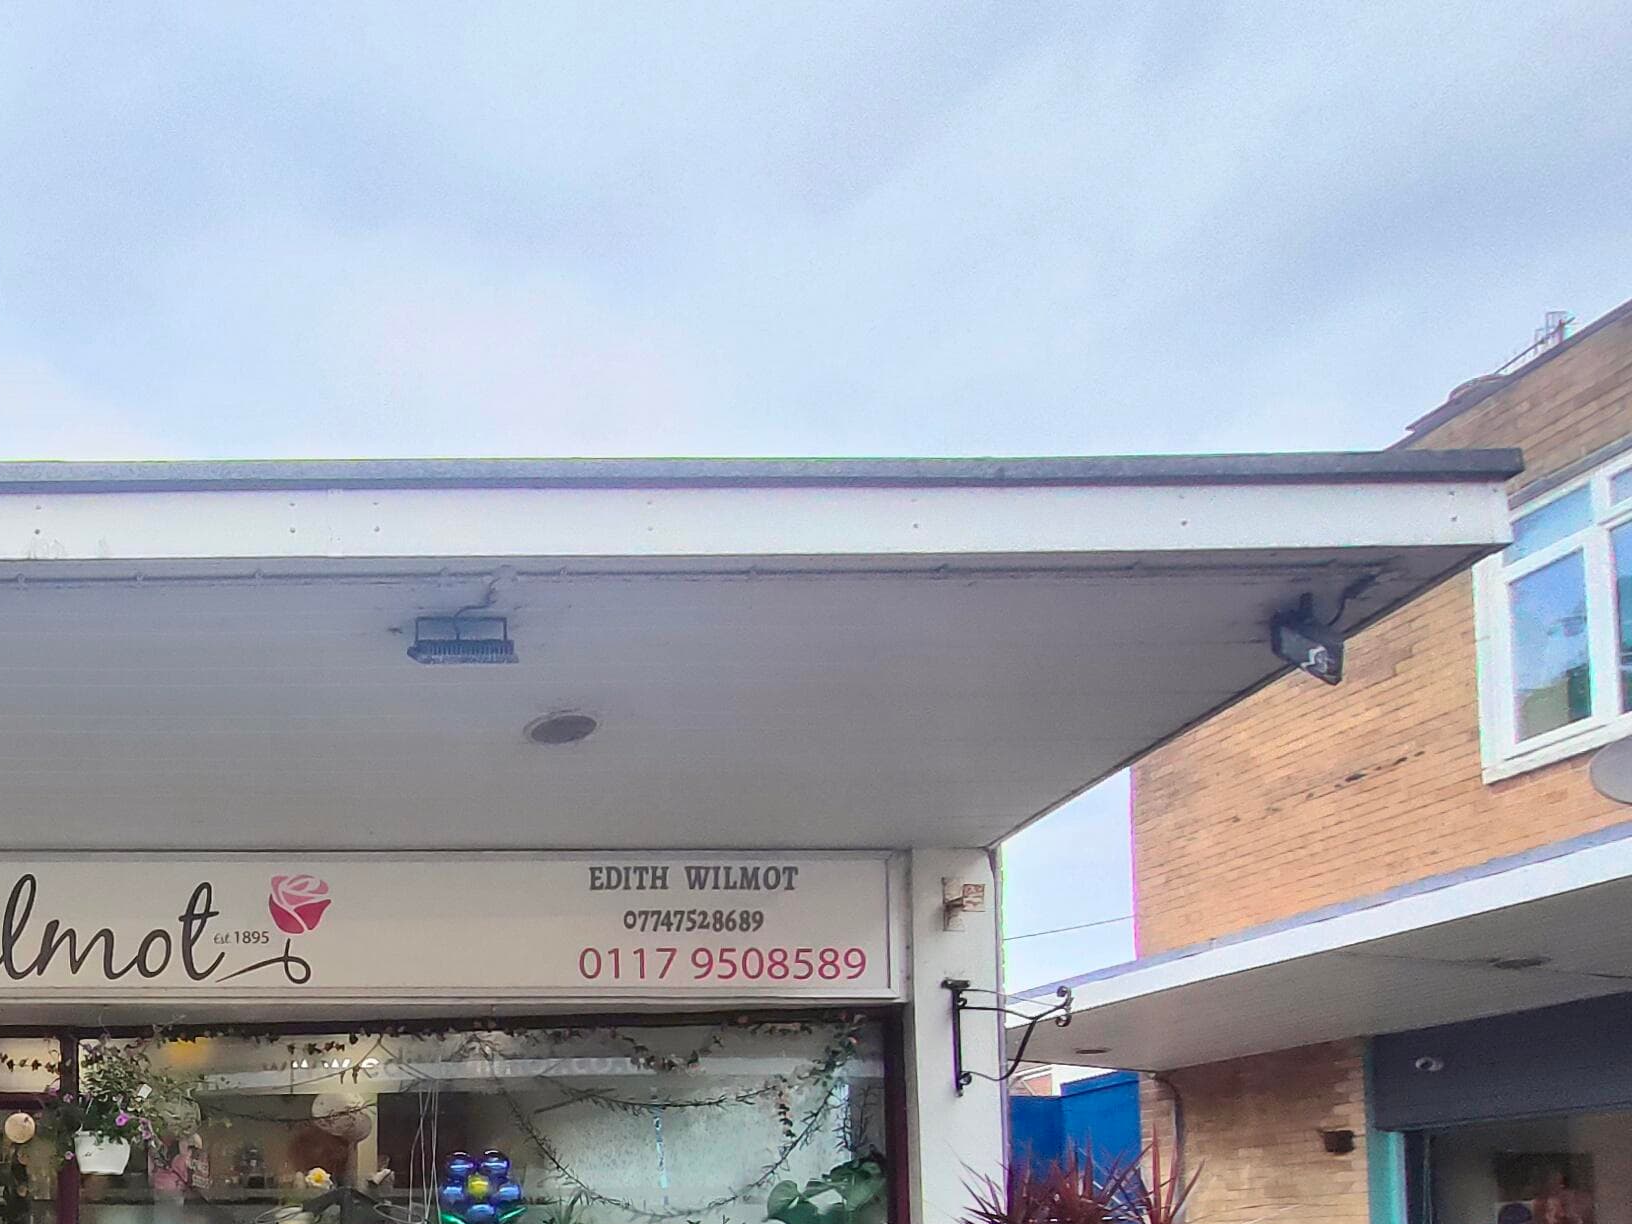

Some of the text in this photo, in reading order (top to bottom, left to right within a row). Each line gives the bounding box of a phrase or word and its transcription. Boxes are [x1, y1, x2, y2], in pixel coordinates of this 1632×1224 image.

[589, 866, 799, 891] EDITH WILMOT
[623, 909, 764, 933] 07747528689
[235, 930, 270, 945] 1895
[579, 947, 867, 980] 0117 9508589
